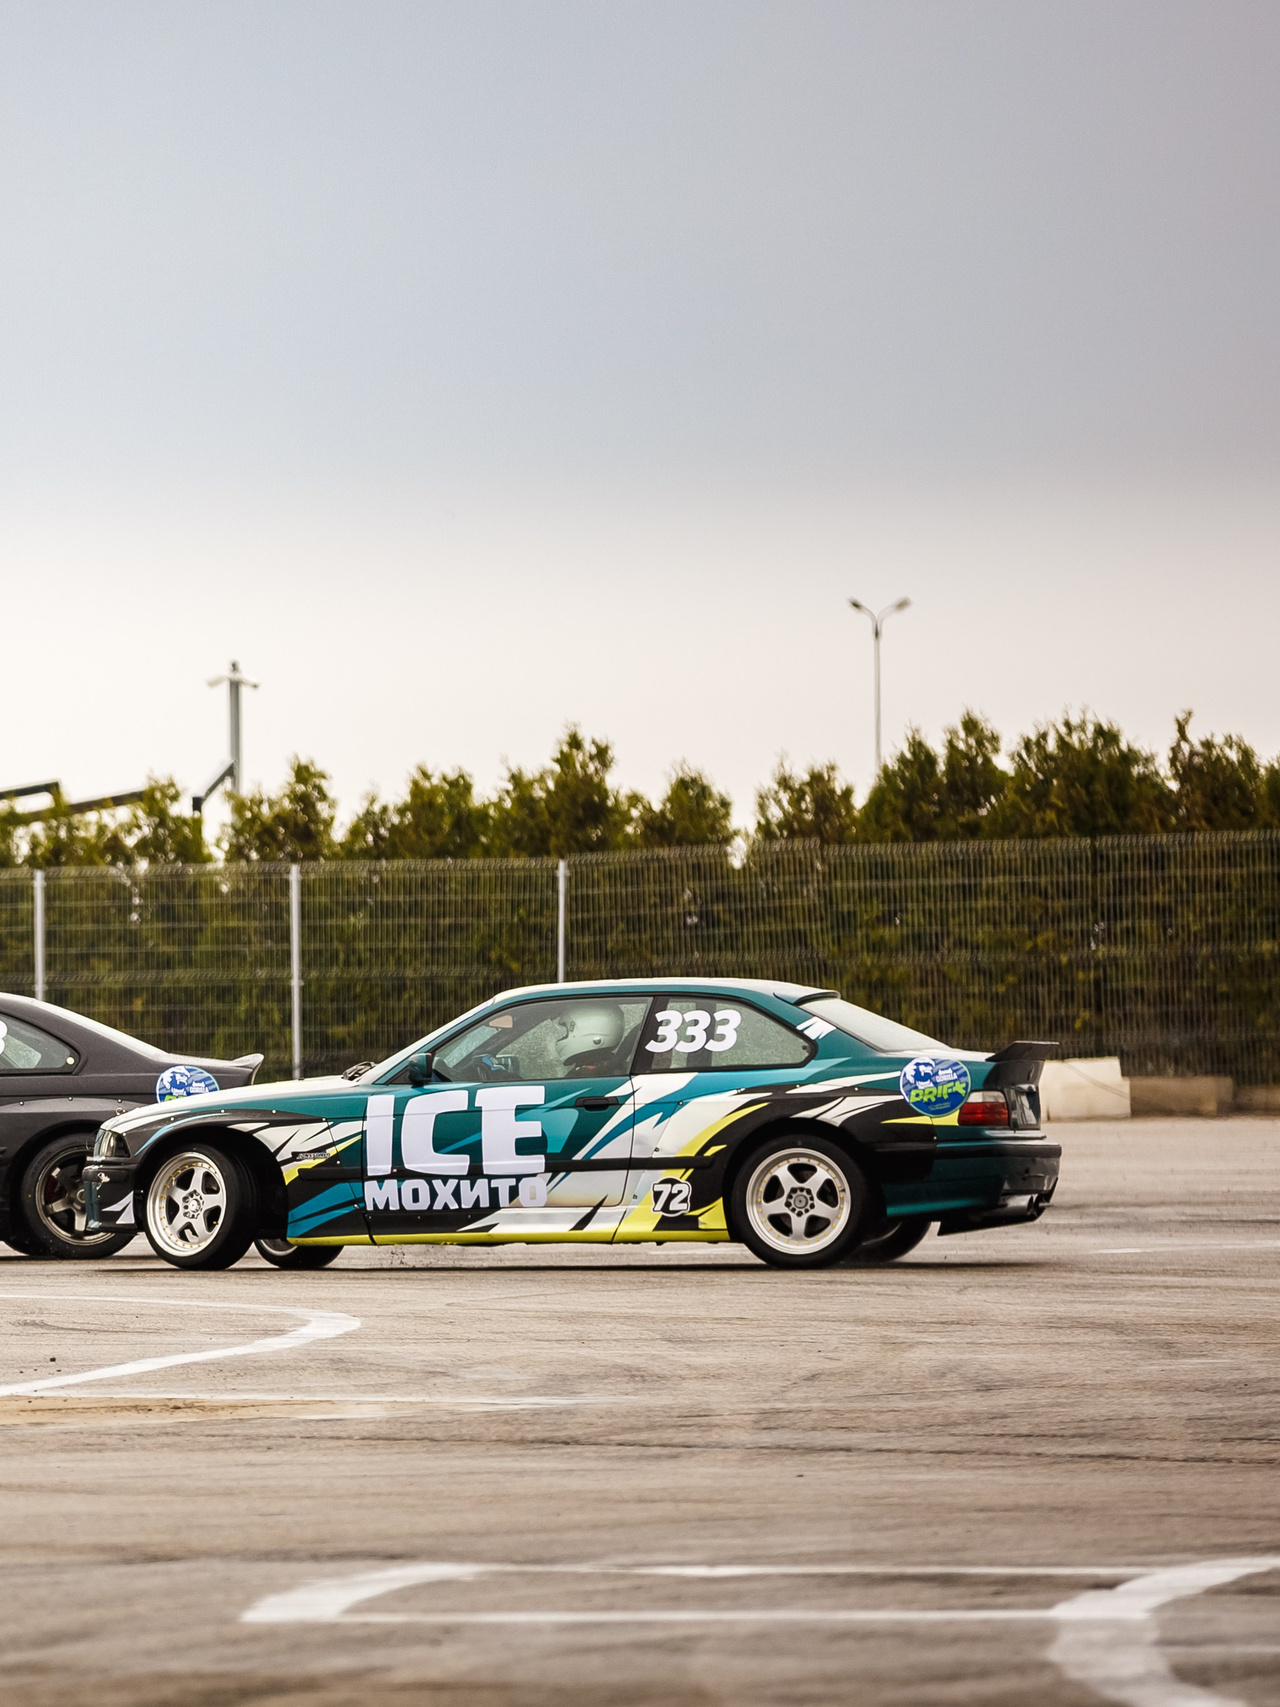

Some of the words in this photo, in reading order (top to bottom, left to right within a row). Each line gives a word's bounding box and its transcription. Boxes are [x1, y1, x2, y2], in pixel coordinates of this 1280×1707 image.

[645, 1009, 742, 1053] 333
[910, 1080, 966, 1103] DRIFT
[935, 1072, 958, 1083] GORILLA
[366, 1085, 545, 1176] ICE
[364, 1177, 548, 1211] МОХИТО
[653, 1183, 690, 1211] 72
